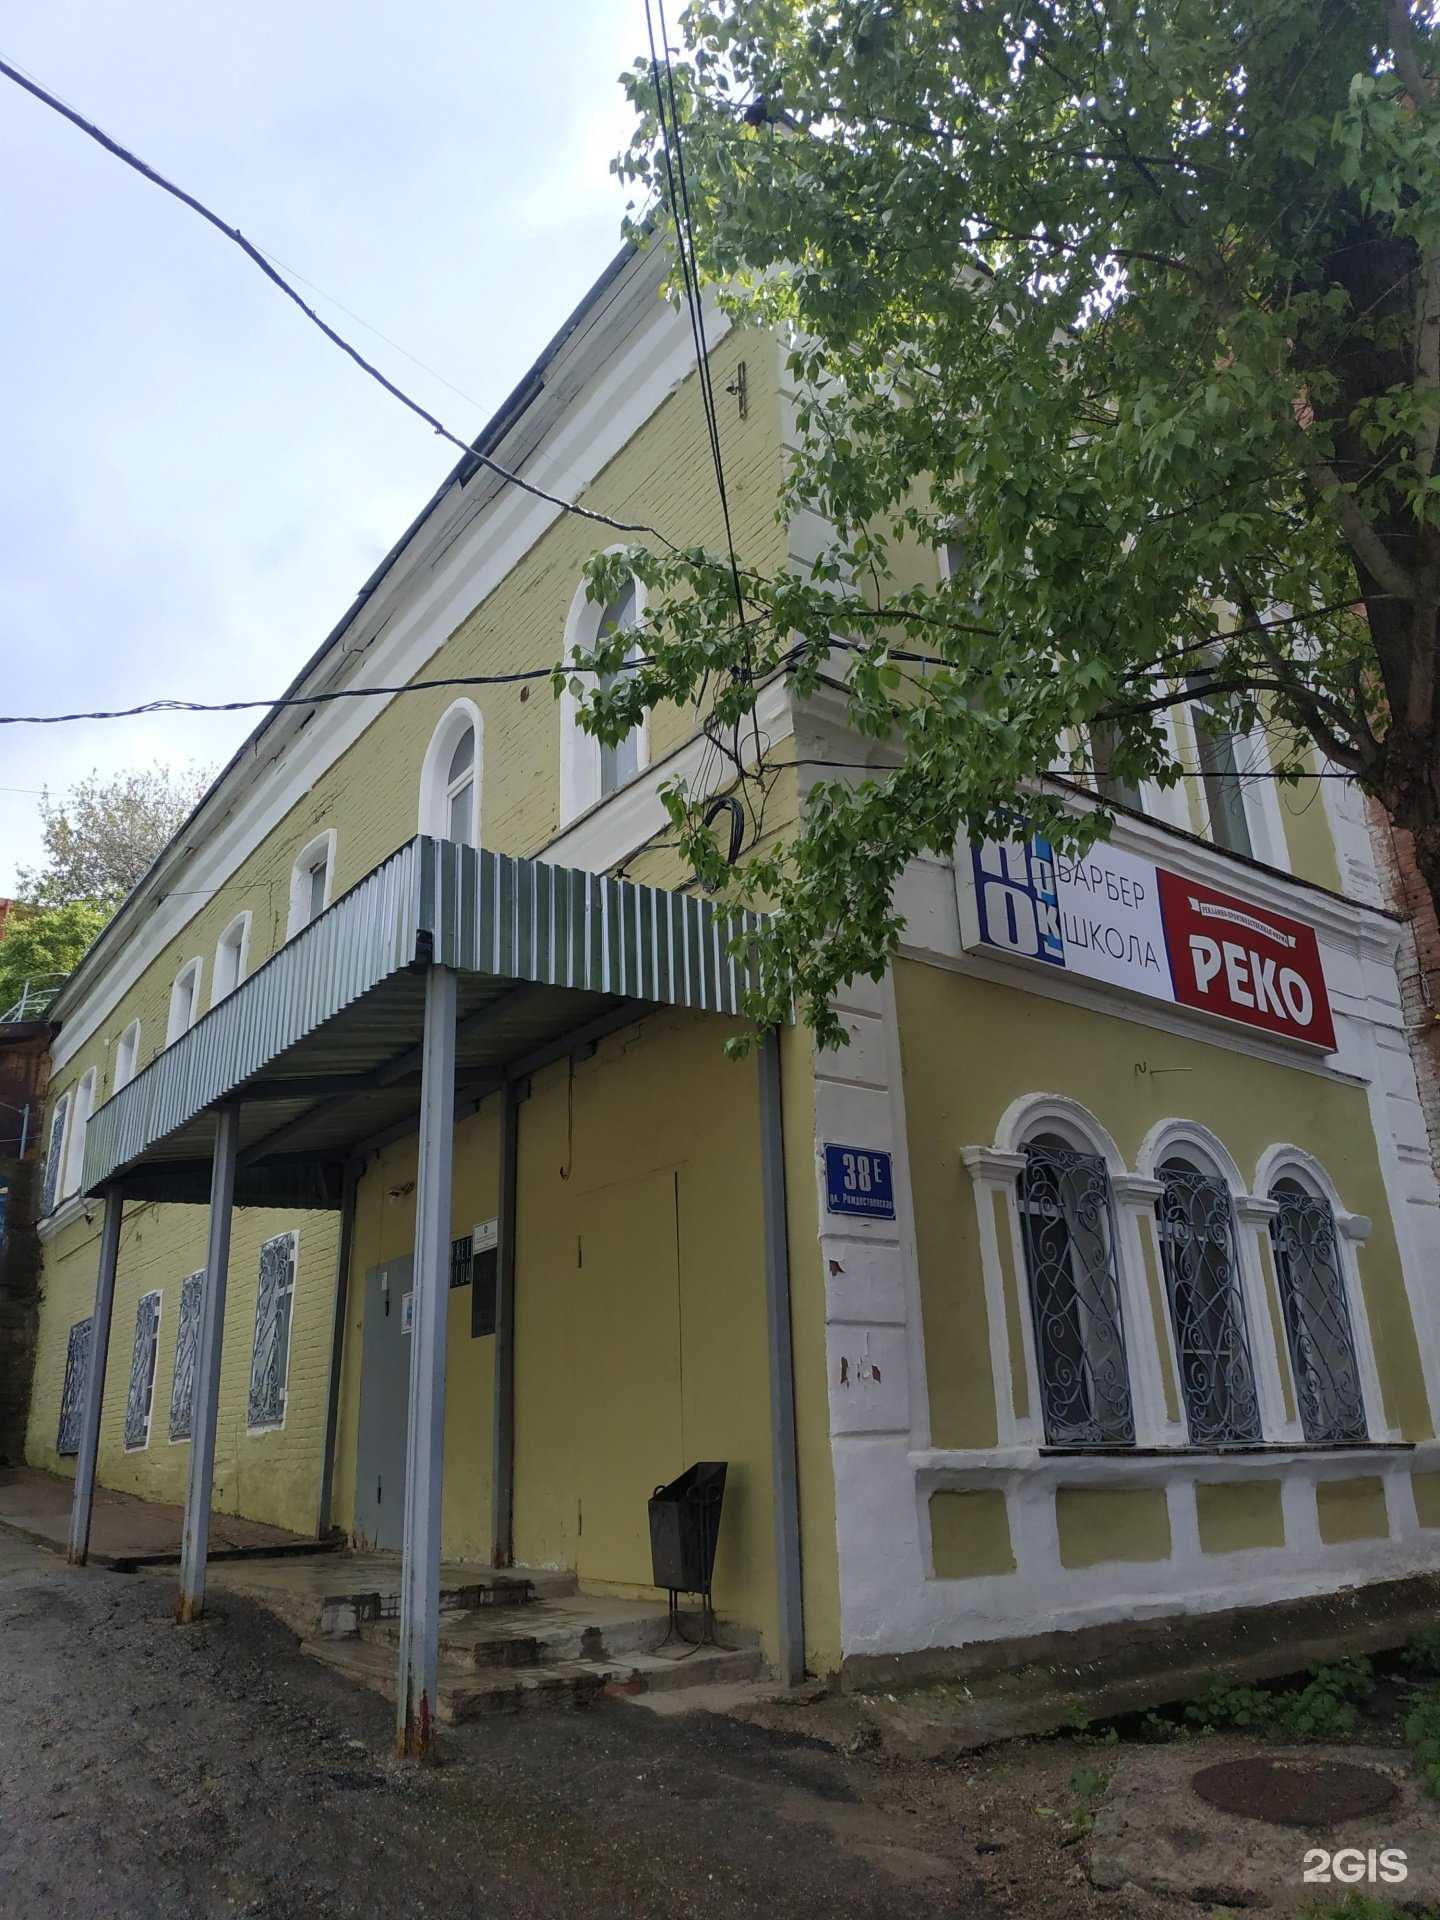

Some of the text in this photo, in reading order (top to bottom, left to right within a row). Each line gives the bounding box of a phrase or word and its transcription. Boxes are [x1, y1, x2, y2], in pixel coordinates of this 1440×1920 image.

[1057, 853, 1145, 909] БАРБЕР
[1063, 911, 1160, 973] ШКОЛА
[1189, 934, 1313, 1026] РЕКО
